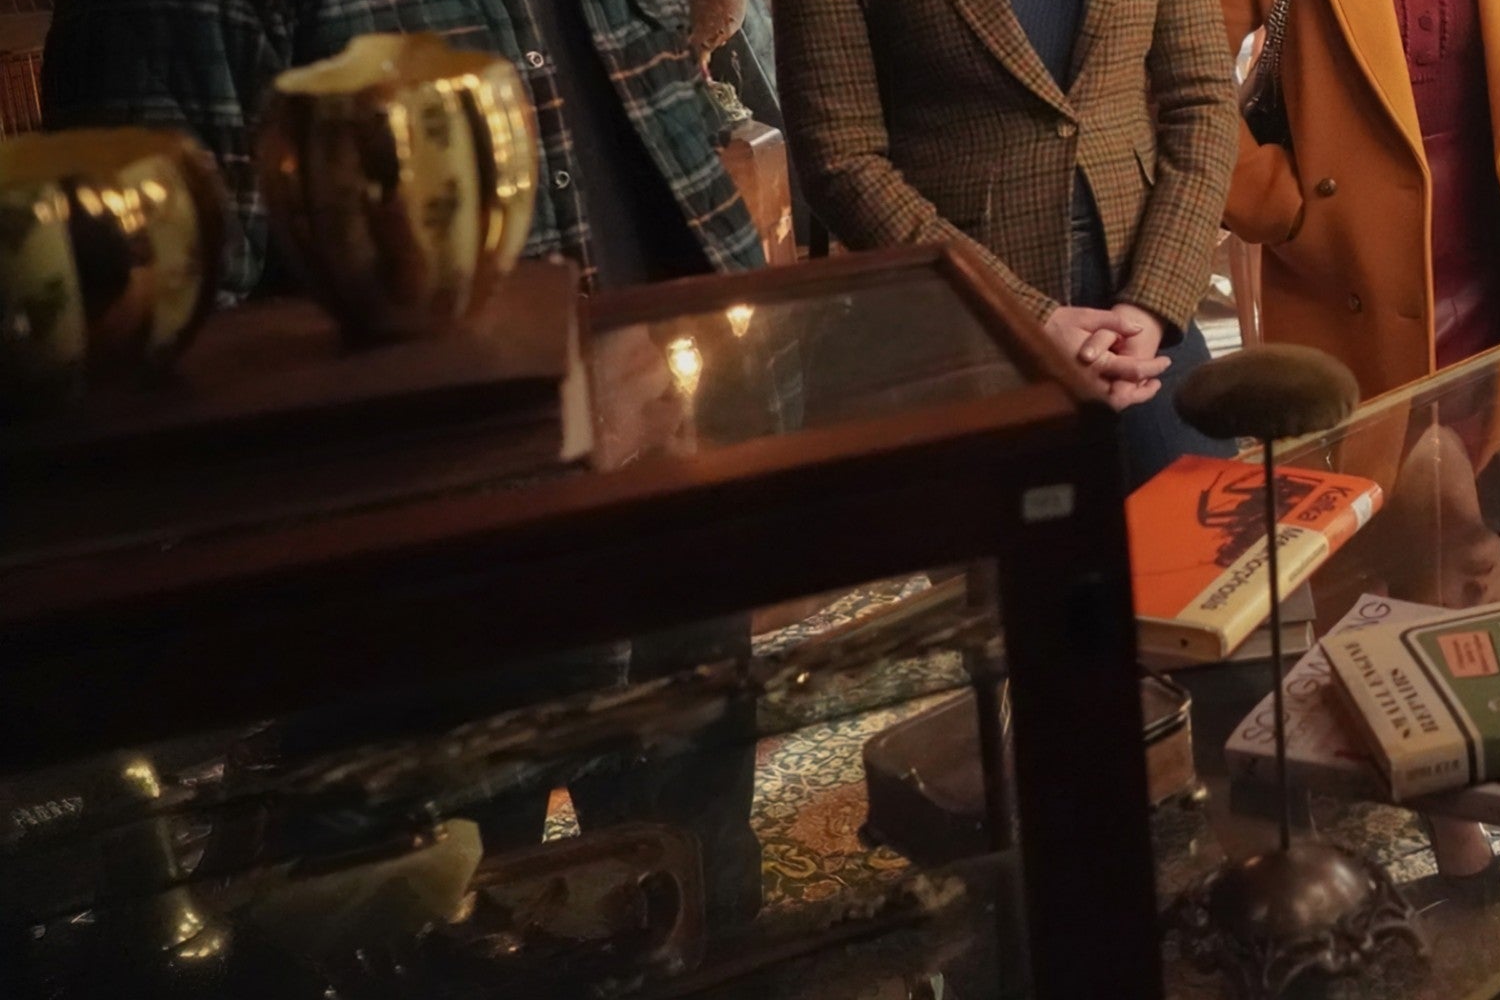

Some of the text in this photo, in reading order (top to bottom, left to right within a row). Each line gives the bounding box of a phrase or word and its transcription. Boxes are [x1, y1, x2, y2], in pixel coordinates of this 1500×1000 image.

[1344, 642, 1411, 740] SMALL ENGINE
[1391, 667, 1440, 733] REPAIRS
